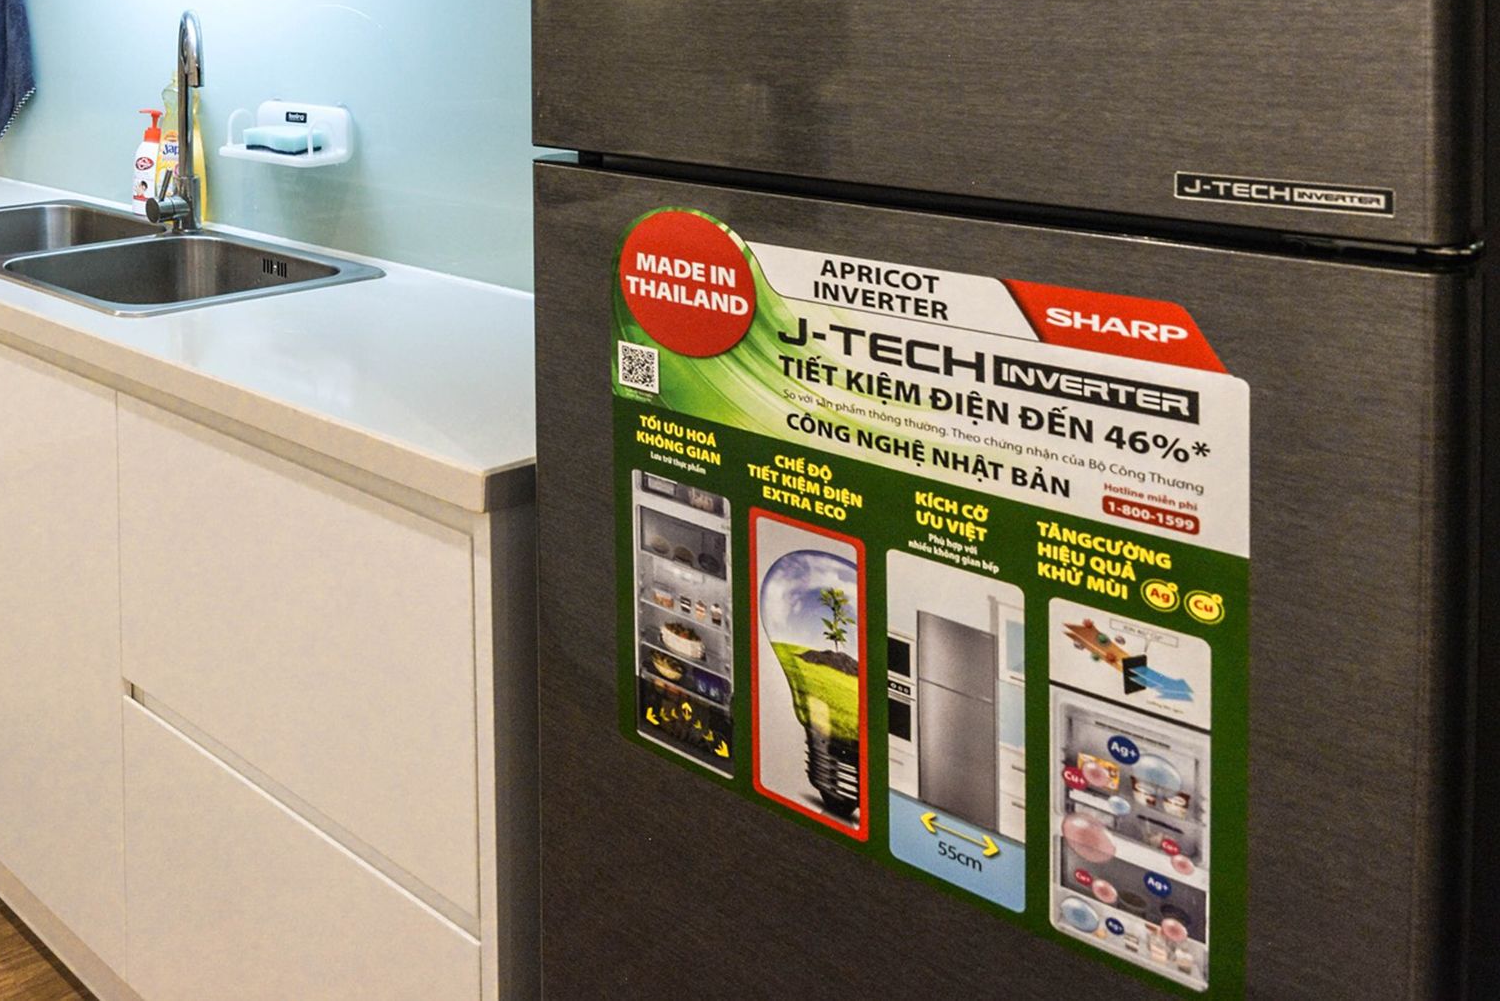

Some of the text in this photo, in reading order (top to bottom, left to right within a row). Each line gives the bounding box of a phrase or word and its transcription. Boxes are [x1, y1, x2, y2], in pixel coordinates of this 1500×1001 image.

[1184, 179, 1382, 207] J-TECH INVERTER
[636, 252, 736, 287] MADE IN
[820, 260, 939, 294] APRICOT
[625, 275, 749, 316] THAILAND
[813, 280, 949, 321] INVERTER
[1045, 306, 1189, 343] SHARP
[777, 317, 1190, 417] J-TECH INVERTER
[778, 354, 842, 386] TIẾT
[846, 369, 921, 405] KIỆM
[929, 388, 1009, 425] ĐIỆN
[1018, 405, 1094, 443] ĐẾN
[636, 430, 721, 466] KHÔNG GIAN
[639, 414, 717, 448] TỐI ƯU HOÁ
[783, 388, 796, 400] So
[951, 427, 981, 443] Theo
[1109, 463, 1146, 483] Công
[1149, 471, 1205, 496] Thương
[774, 454, 833, 484] CHẾ ĐỘ
[787, 412, 1070, 498] CÔNG NGHỆ NHẬT BẢN
[747, 463, 863, 508] TIẾT KIỆM ĐIỆN
[1104, 483, 1145, 498] Hotline
[763, 485, 847, 521] EXTRA ECO
[915, 491, 989, 522] KÍCH CỠ
[1108, 501, 1195, 531] 1-800-1599
[916, 510, 988, 542] ƯU VIỆT
[961, 555, 981, 568] gian
[1037, 542, 1137, 581] HIỆU QUẢ
[1037, 561, 1129, 600] KHỬ MÙI
[1110, 741, 1137, 760] Ag+
[1063, 770, 1086, 785] Cu+
[938, 841, 983, 872] 55cm
[1147, 878, 1168, 893] Ag+
